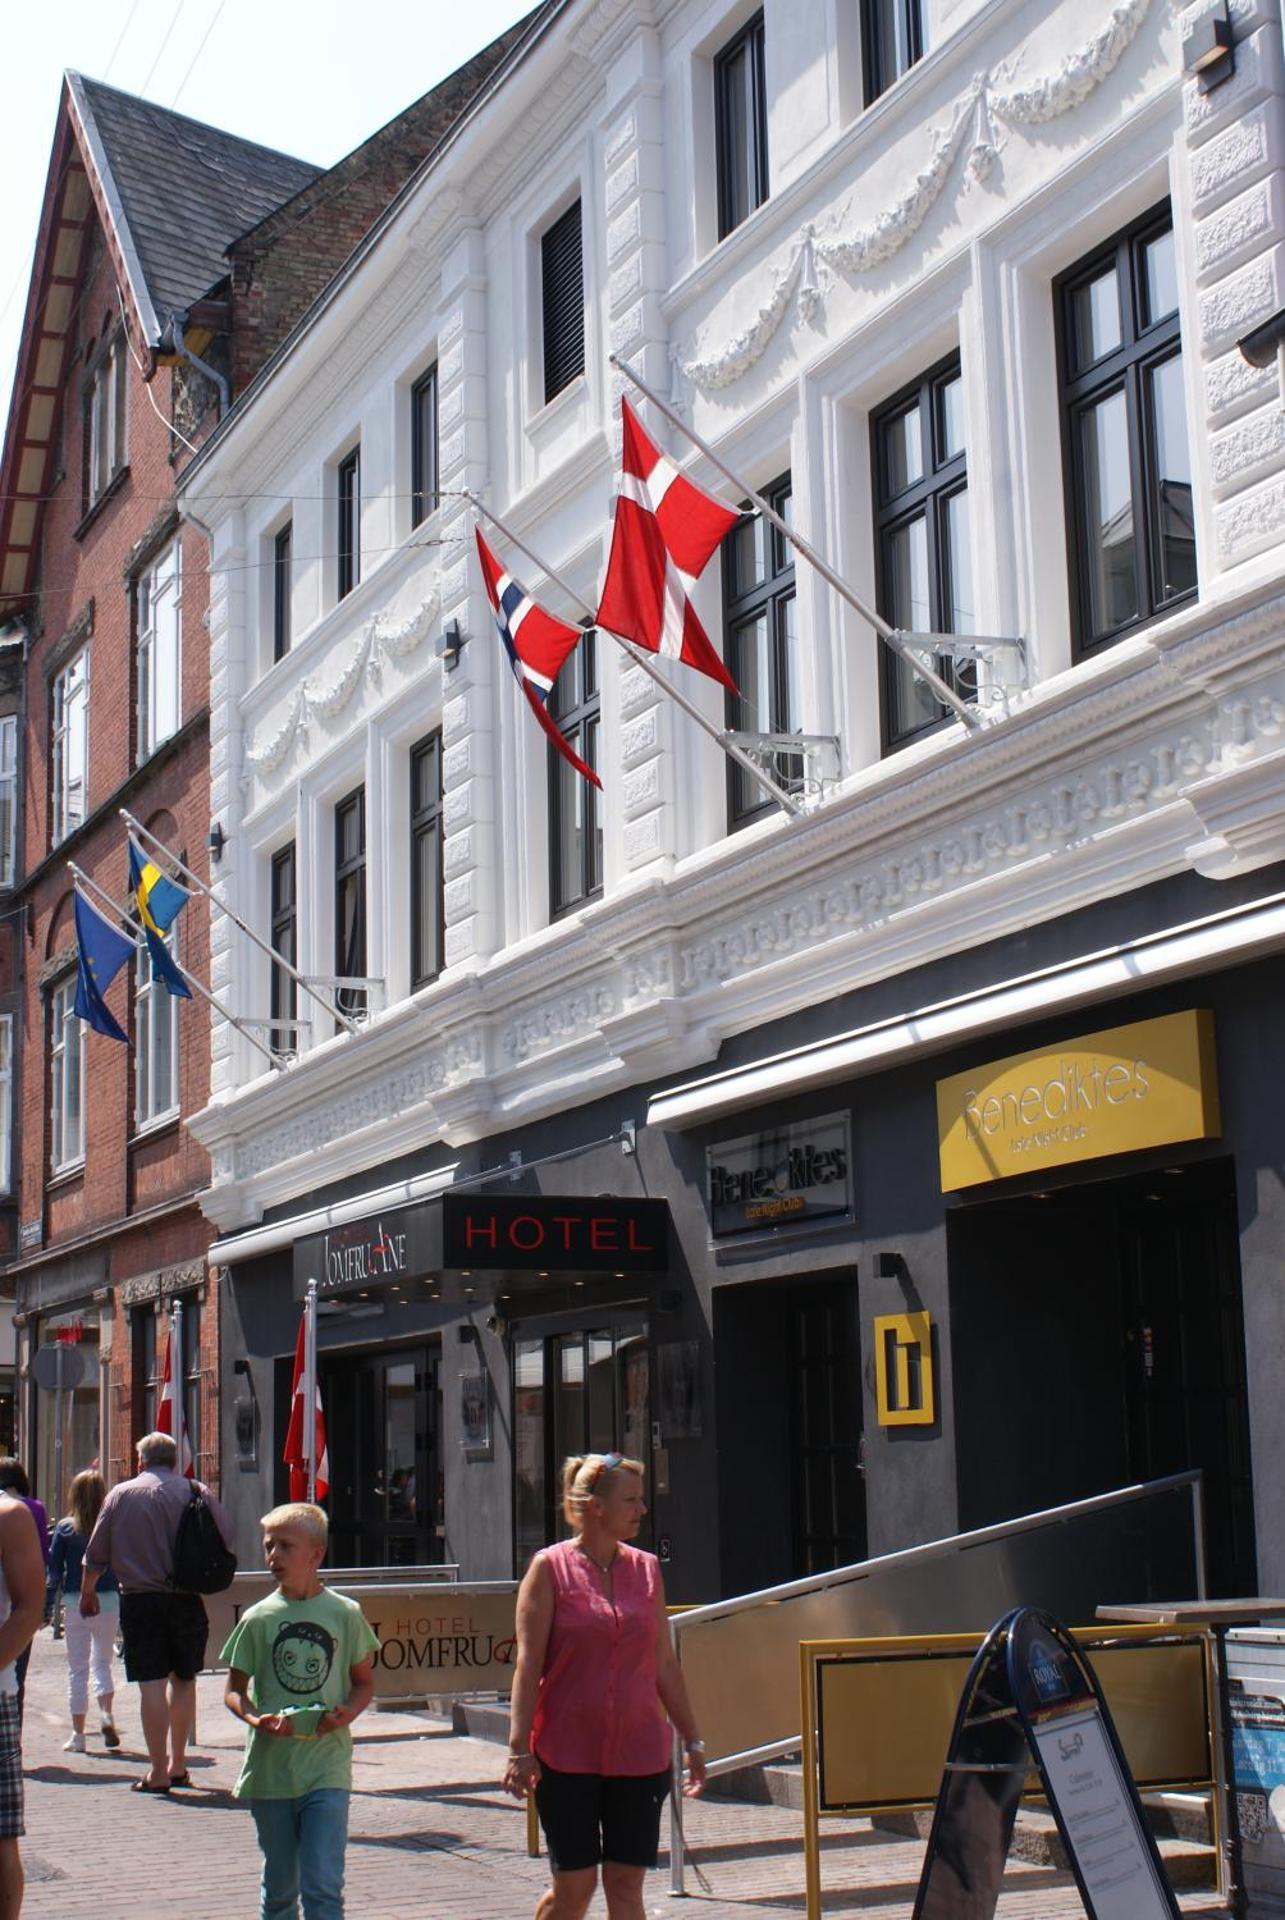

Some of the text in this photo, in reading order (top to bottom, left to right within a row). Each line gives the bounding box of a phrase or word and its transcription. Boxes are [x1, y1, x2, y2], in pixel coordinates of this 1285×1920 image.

[963, 1058, 1149, 1140] Benediktes
[464, 1215, 655, 1251] HOTEL
[396, 1617, 482, 1636] HOTEL
